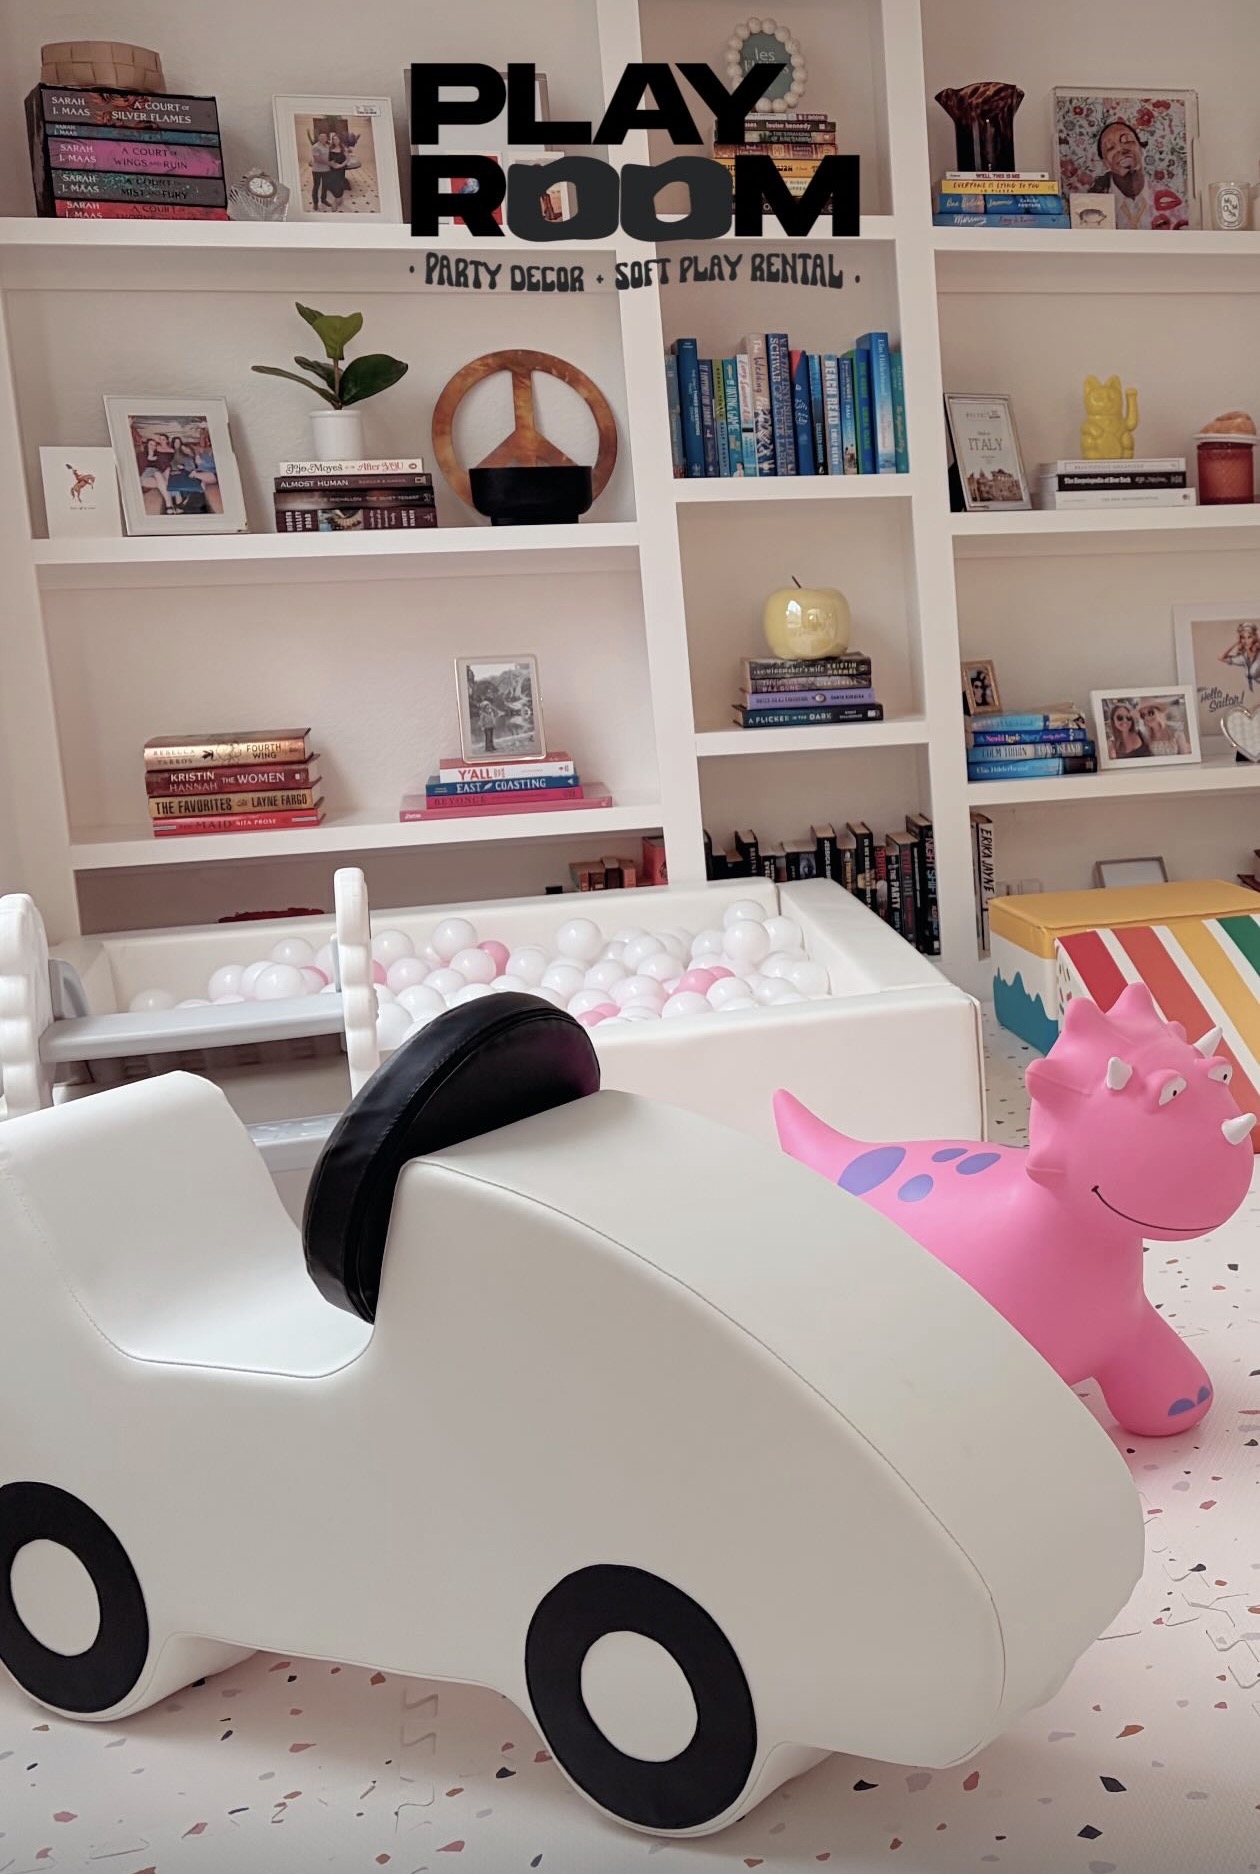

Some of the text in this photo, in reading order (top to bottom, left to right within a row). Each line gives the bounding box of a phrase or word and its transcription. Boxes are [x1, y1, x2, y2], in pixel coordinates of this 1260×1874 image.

[52, 97, 85, 106] SARAH
[134, 102, 141, 110] A
[145, 102, 179, 111] COURT
[62, 107, 90, 116] MAAS
[111, 112, 192, 124] SILVER FLAMES
[60, 144, 93, 153] SARAH
[132, 148, 168, 157] COURT
[68, 155, 96, 164] MAAS
[113, 158, 188, 169] WINGS RUIN
[63, 174, 96, 183] SARAH
[71, 184, 99, 193] MAAS
[121, 187, 145, 197] MIST
[66, 201, 100, 209] SARAH
[75, 211, 102, 219] MAAS
[770, 337, 781, 382] SCHWAB
[825, 360, 837, 394] BEACH
[827, 398, 839, 425] READ
[968, 438, 1002, 451] ITALY
[307, 463, 343, 474] Moyes
[317, 479, 349, 487] HUMAN
[1200, 686, 1223, 703] Hello
[246, 743, 282, 752] FOURTH
[170, 771, 215, 782] KRISTIN
[237, 772, 285, 784] WOMEN
[458, 768, 493, 781] Y'ALL
[169, 781, 218, 793] HANNAH
[456, 782, 481, 794] EAST
[495, 778, 547, 791] COASTING
[155, 801, 175, 815] THE
[178, 798, 232, 814] FAVORITES
[251, 797, 279, 808] LAYNE
[281, 793, 308, 806] FARGO
[925, 838, 937, 867] NIGHT
[980, 828, 995, 893] ERIKA JAYNE
[927, 869, 937, 898] SHIFT
[890, 881, 900, 909] PARTY
